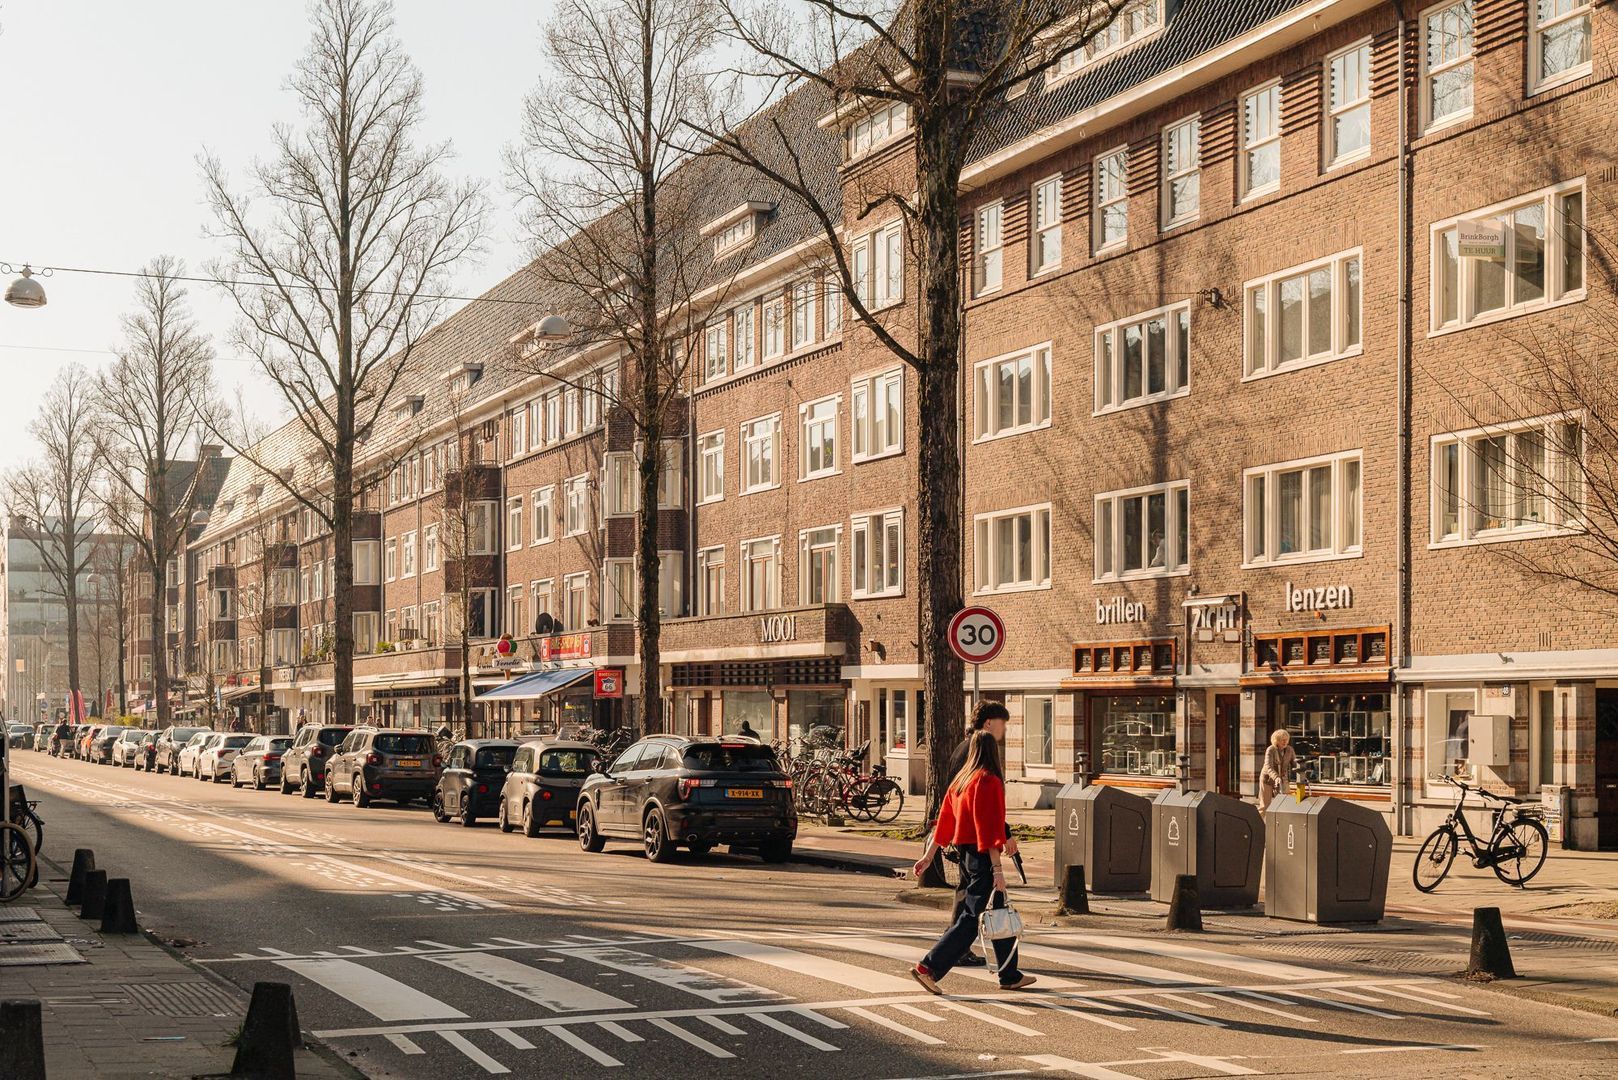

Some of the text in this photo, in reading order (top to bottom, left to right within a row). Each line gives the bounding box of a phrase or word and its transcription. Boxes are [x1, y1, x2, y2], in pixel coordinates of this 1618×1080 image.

[1460, 233, 1499, 241] BrinkBorgh
[1286, 581, 1351, 611] lenzen
[1096, 596, 1144, 624] brillen
[1191, 604, 1237, 635] ZICHT
[761, 615, 796, 642] MOOI
[961, 624, 995, 646] 30
